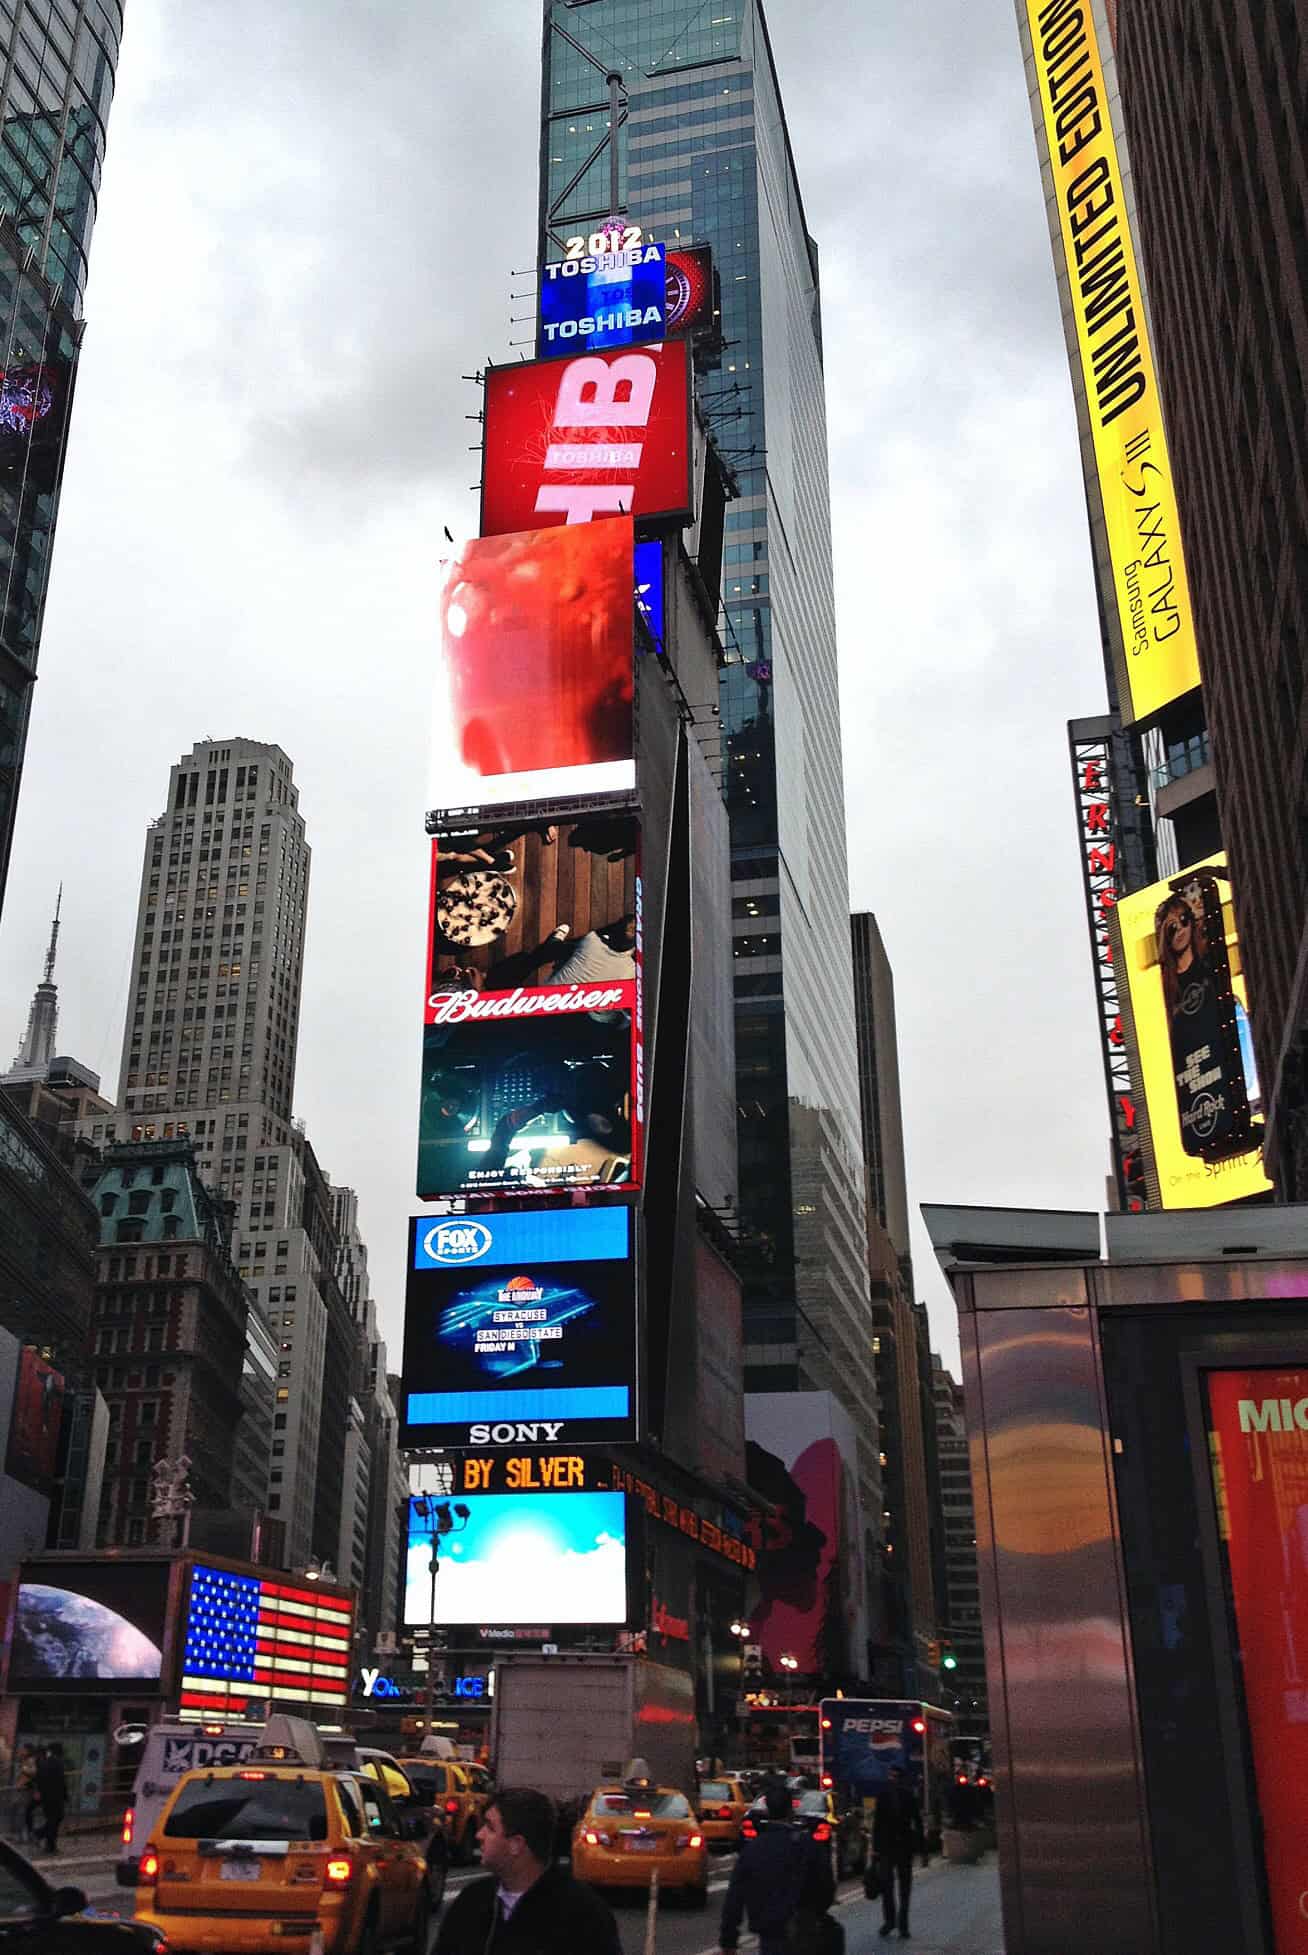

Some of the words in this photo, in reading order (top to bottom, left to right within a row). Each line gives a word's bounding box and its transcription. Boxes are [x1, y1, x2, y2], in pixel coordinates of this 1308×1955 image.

[1038, 0, 1102, 166] EDITION
[566, 226, 642, 260] 2012
[545, 246, 662, 279] TOSHIBA
[1068, 156, 1146, 427] UNLIMITED
[544, 306, 662, 341] TOSHIBA
[1135, 502, 1181, 642] GALAXY
[1124, 559, 1149, 656] Samsung
[428, 985, 623, 1024] Budweiser
[1185, 1044, 1211, 1068] SEE
[437, 1228, 479, 1250] FOX
[494, 1310, 545, 1321] SYRACUSE
[478, 1330, 499, 1340] SAN
[501, 1329, 529, 1340] DIEGO
[530, 1327, 561, 1339] STATE
[469, 1423, 564, 1445] SONY
[464, 1459, 495, 1489] BY
[505, 1456, 585, 1489] SILVER
[842, 1718, 904, 1734] PEPSI
